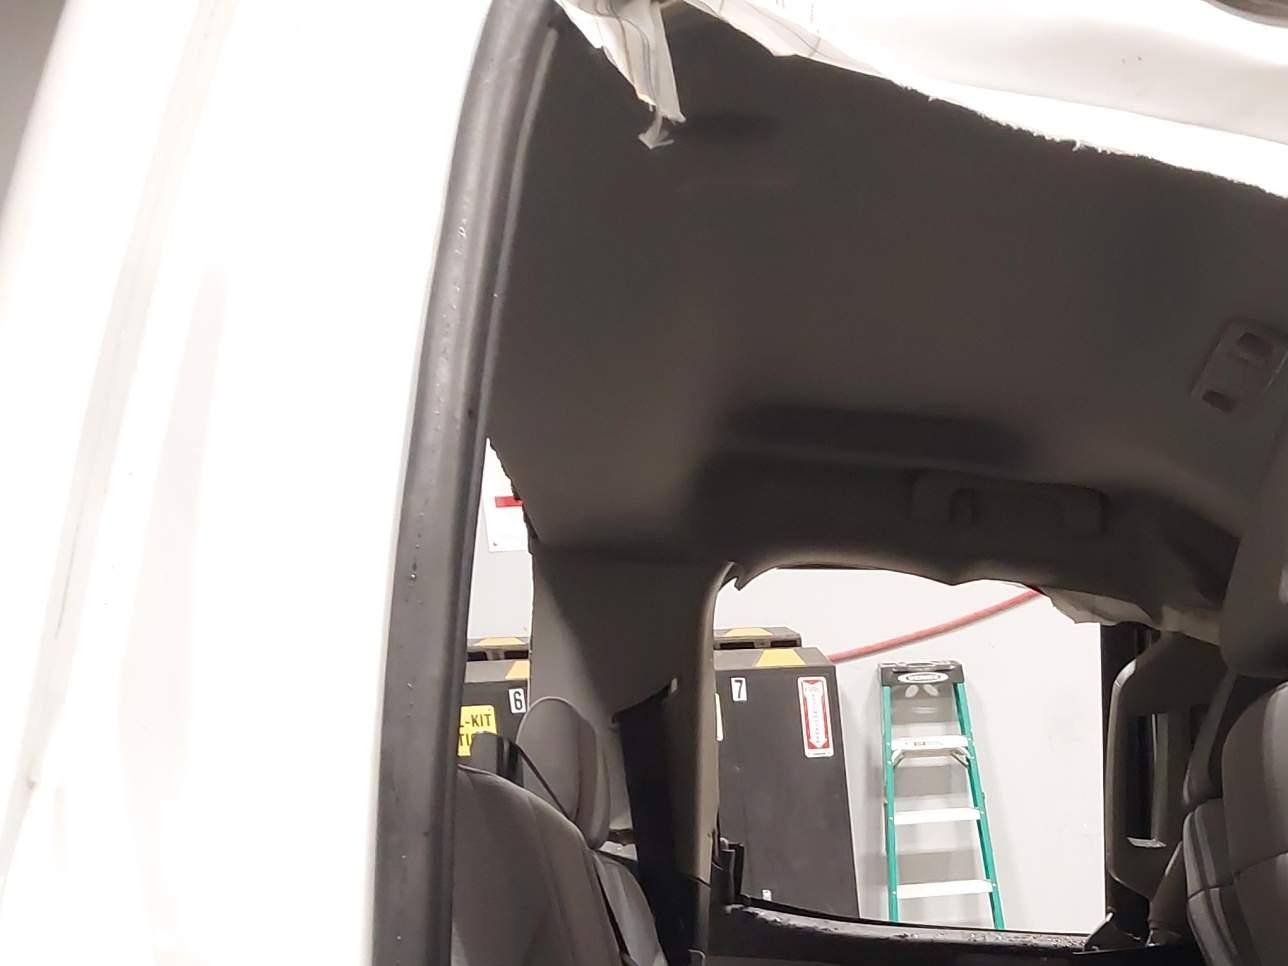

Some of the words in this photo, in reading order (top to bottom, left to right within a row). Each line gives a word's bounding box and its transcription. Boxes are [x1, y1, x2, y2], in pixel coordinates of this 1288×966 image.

[734, 679, 744, 699] 7
[513, 691, 523, 711] 6
[460, 713, 492, 728] -KIT
